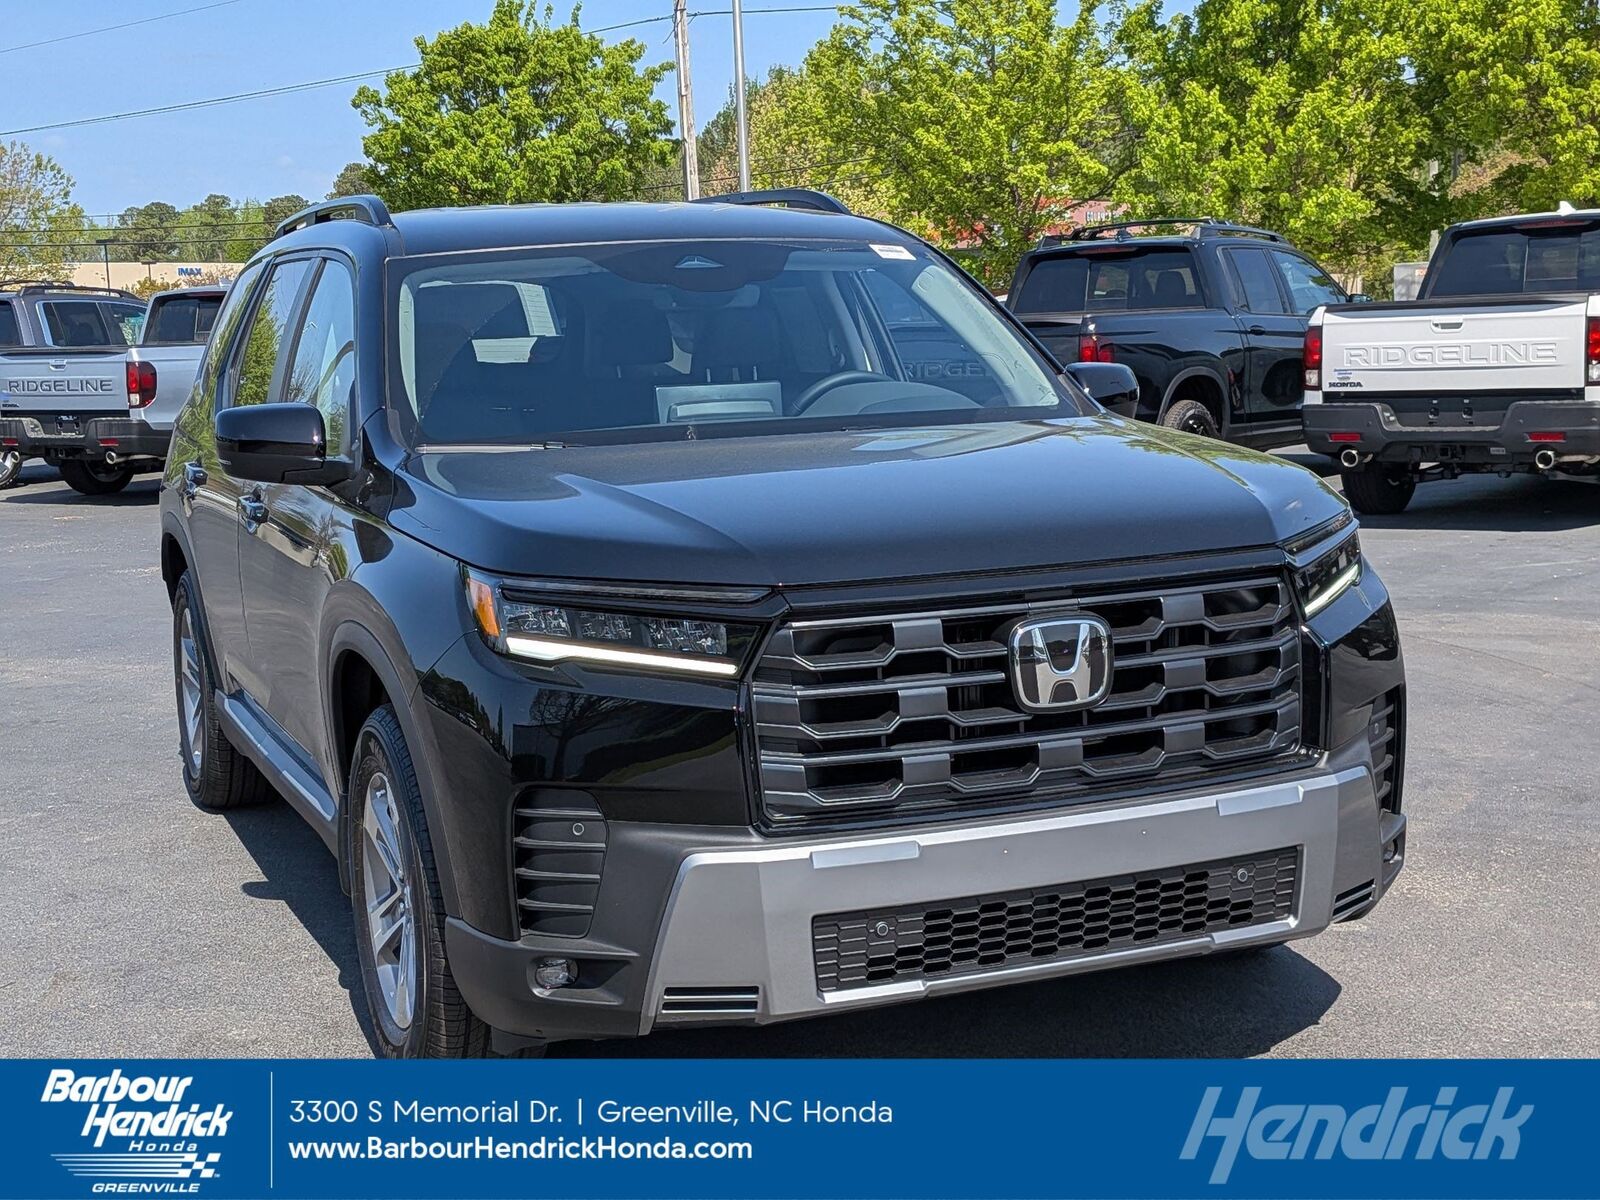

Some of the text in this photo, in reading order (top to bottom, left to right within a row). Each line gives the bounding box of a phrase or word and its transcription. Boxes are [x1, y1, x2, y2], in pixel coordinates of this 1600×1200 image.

[177, 267, 202, 276] IMAX
[1343, 343, 1557, 366] RIDGELINE
[8, 380, 113, 392] RIDGELINE
